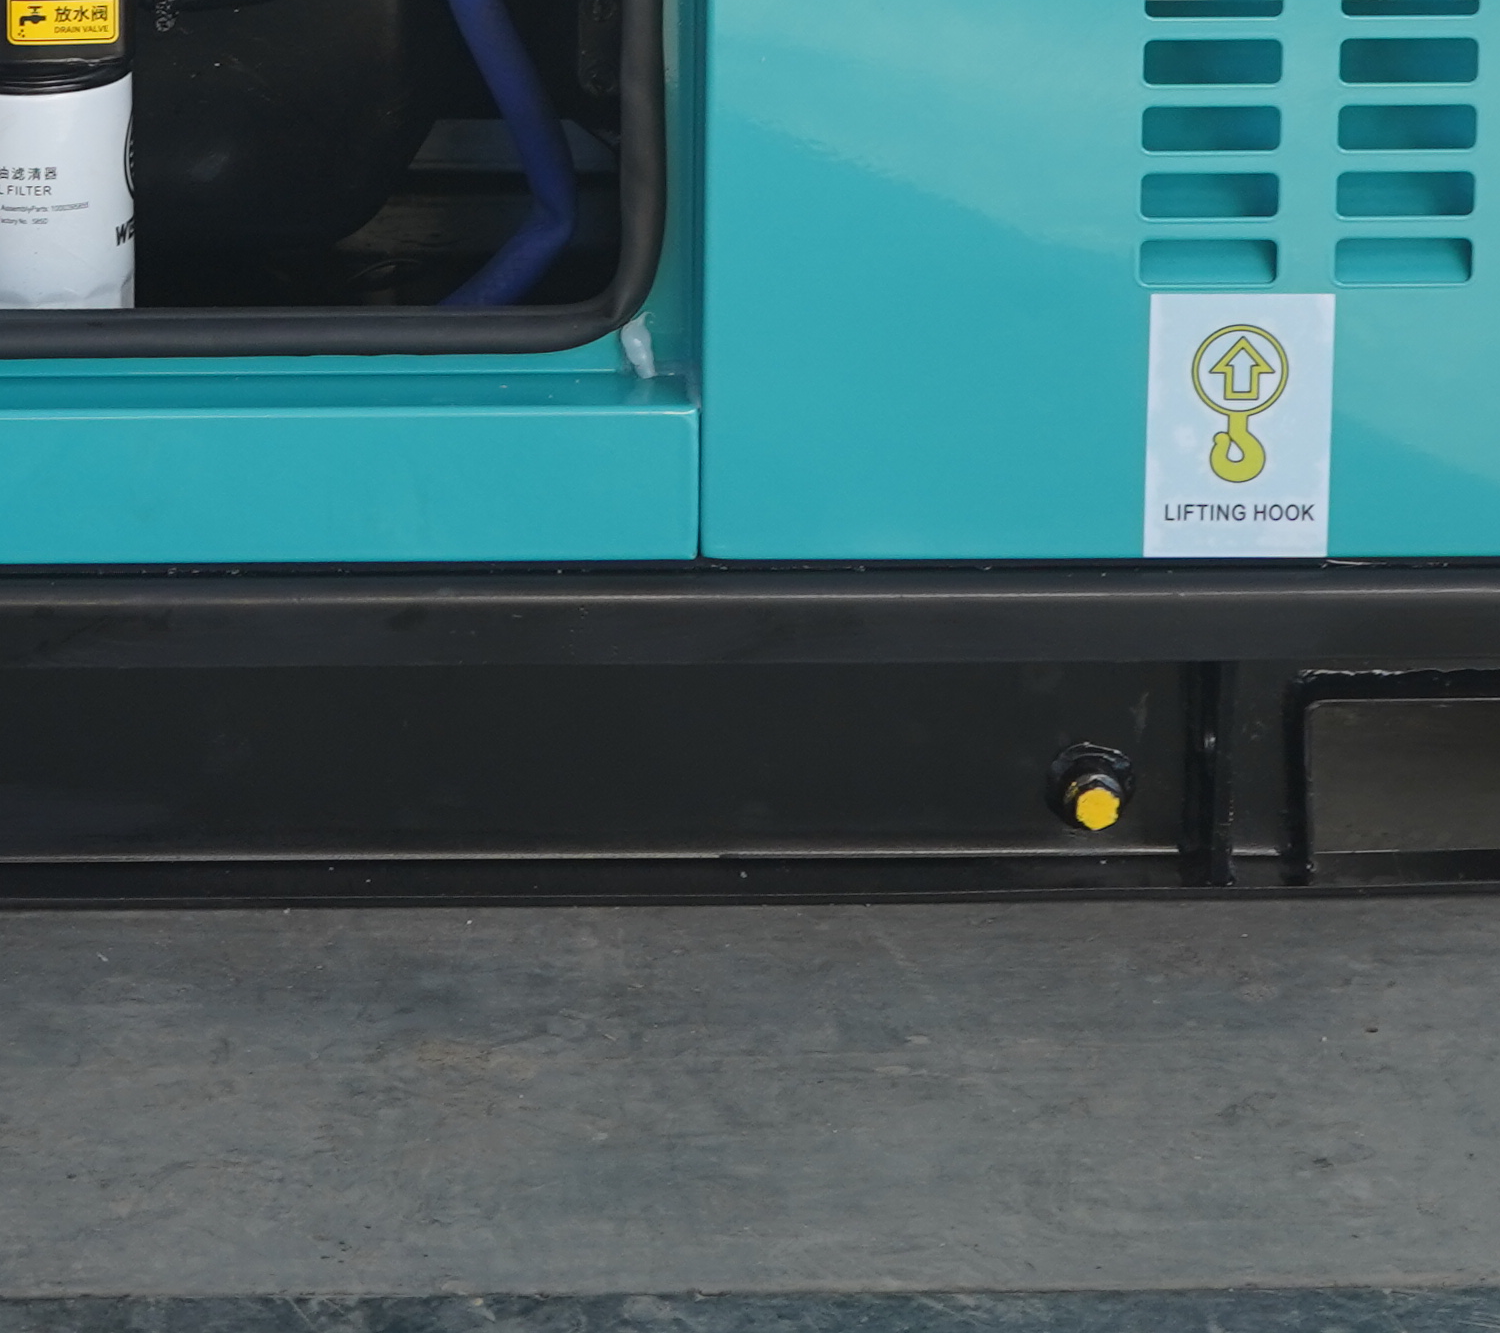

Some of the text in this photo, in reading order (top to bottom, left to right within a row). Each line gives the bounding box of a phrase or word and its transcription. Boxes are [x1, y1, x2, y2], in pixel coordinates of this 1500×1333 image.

[54, 5, 109, 24] 放水阀
[54, 24, 109, 34] DRAIN VALVE
[7, 184, 52, 196] FILTER
[1164, 503, 1315, 522] LIFTING HOOK
